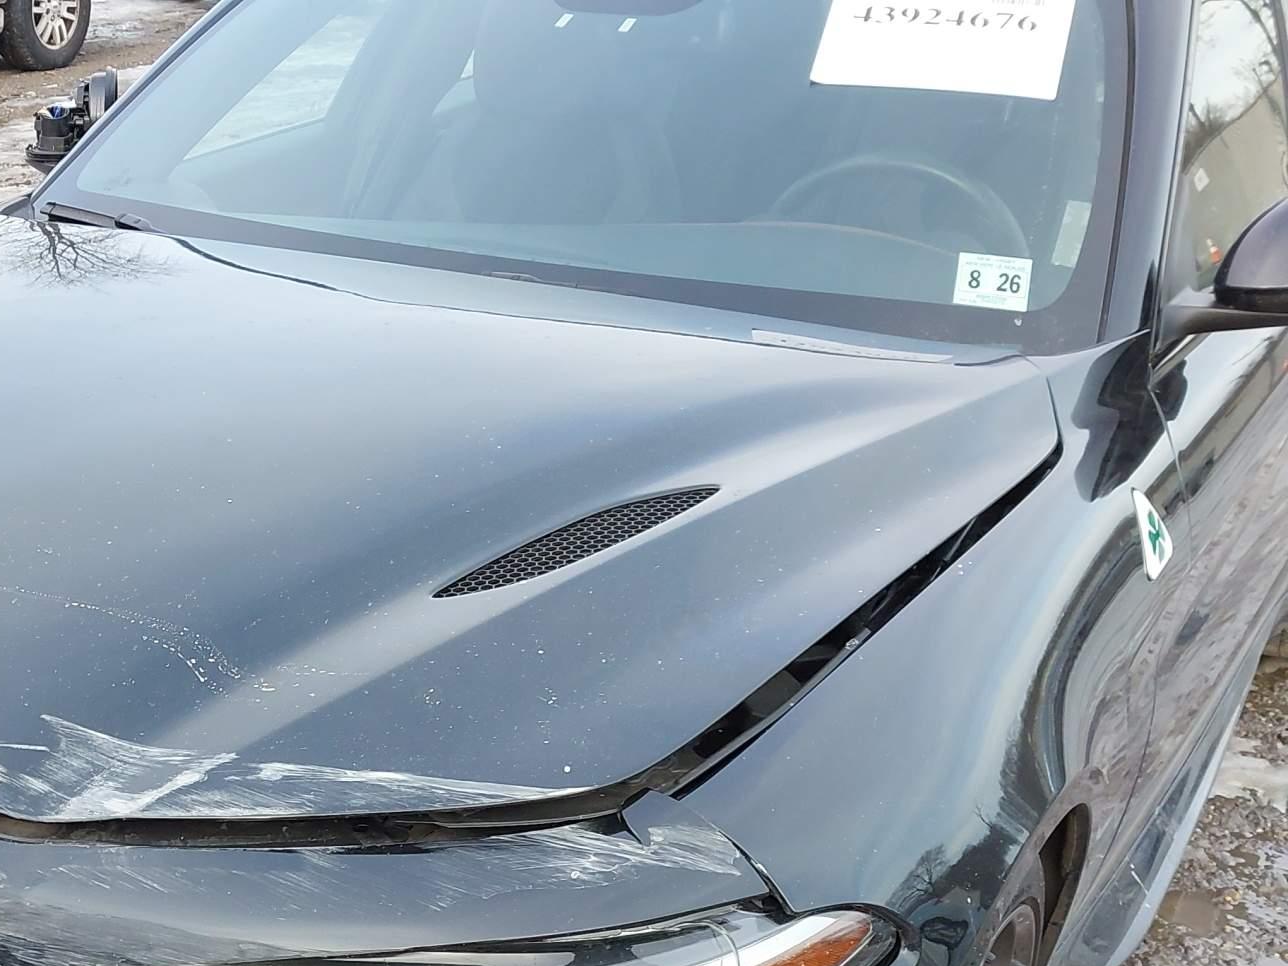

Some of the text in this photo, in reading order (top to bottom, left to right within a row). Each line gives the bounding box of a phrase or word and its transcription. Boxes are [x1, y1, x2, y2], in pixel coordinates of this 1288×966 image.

[853, 6, 1038, 32] 43924676
[968, 269, 1022, 294] 8 26
